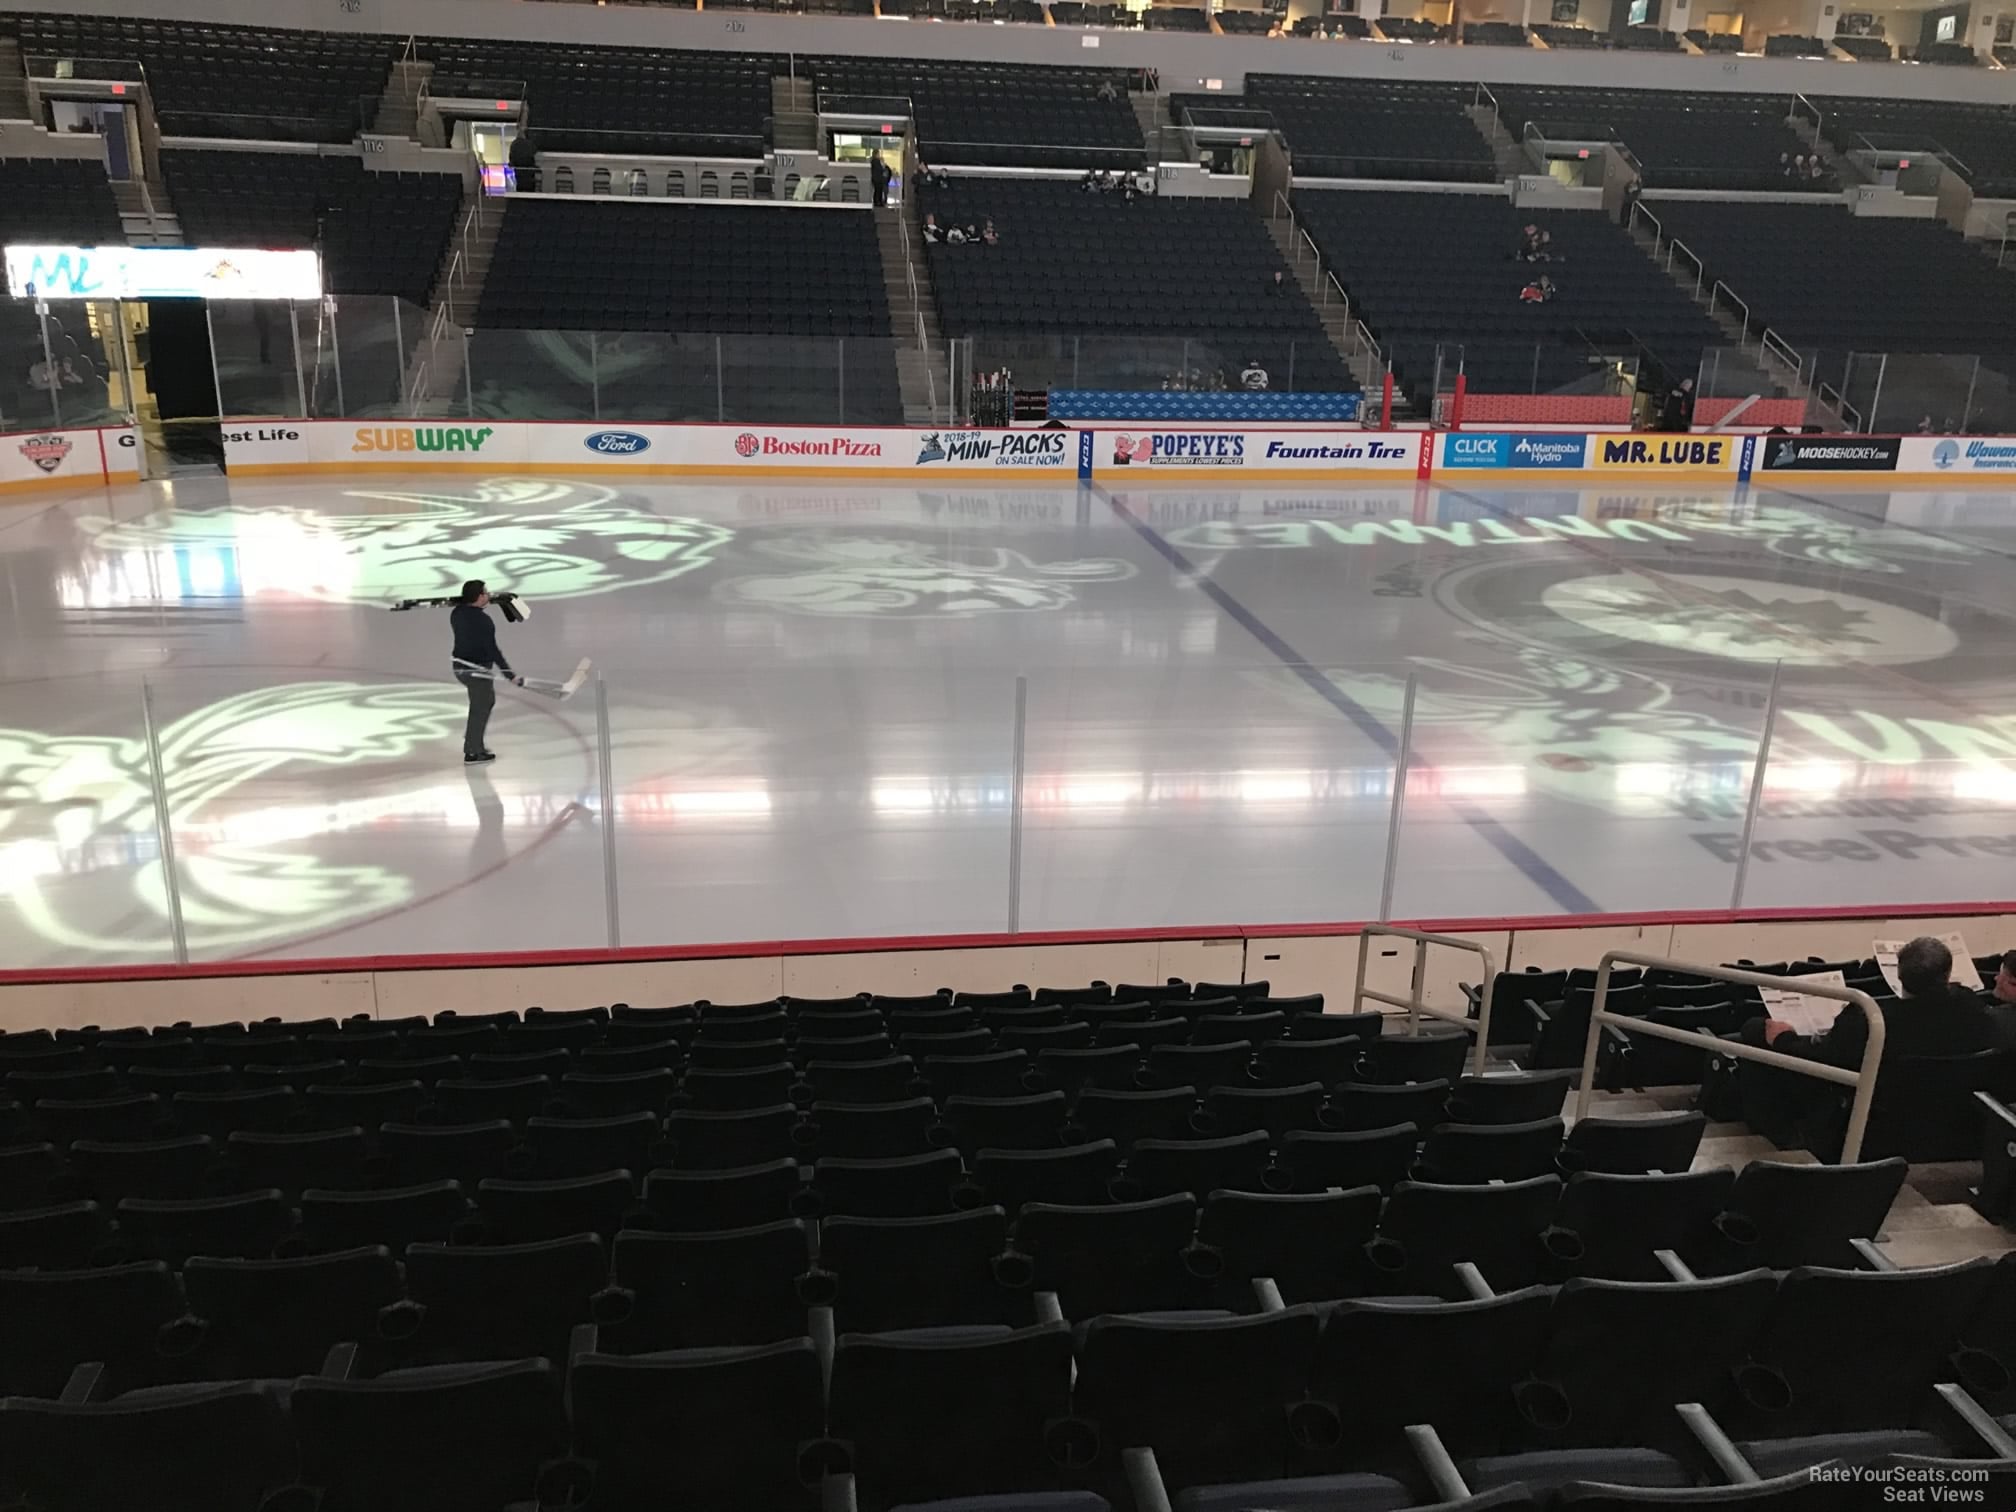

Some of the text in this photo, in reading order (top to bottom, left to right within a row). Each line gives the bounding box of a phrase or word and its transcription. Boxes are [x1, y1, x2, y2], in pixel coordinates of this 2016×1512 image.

[363, 140, 384, 152] 116
[775, 155, 794, 167] 117
[258, 429, 299, 441] Life
[352, 427, 494, 453] SUBWAY
[944, 431, 981, 443] 2018-19
[597, 434, 637, 452] Ford
[763, 436, 882, 457] Boston Pizza
[947, 433, 1066, 462] MINI-PACKS
[1151, 434, 1244, 456] POPEYE'S
[1266, 441, 1406, 458] Fountain Tire
[1455, 439, 1498, 453] CLICK
[1532, 443, 1580, 453] Manitoba
[995, 453, 1066, 465] ON SALE NOW!
[1531, 453, 1562, 464] Hydro
[1604, 440, 1723, 464] MR. LUBE
